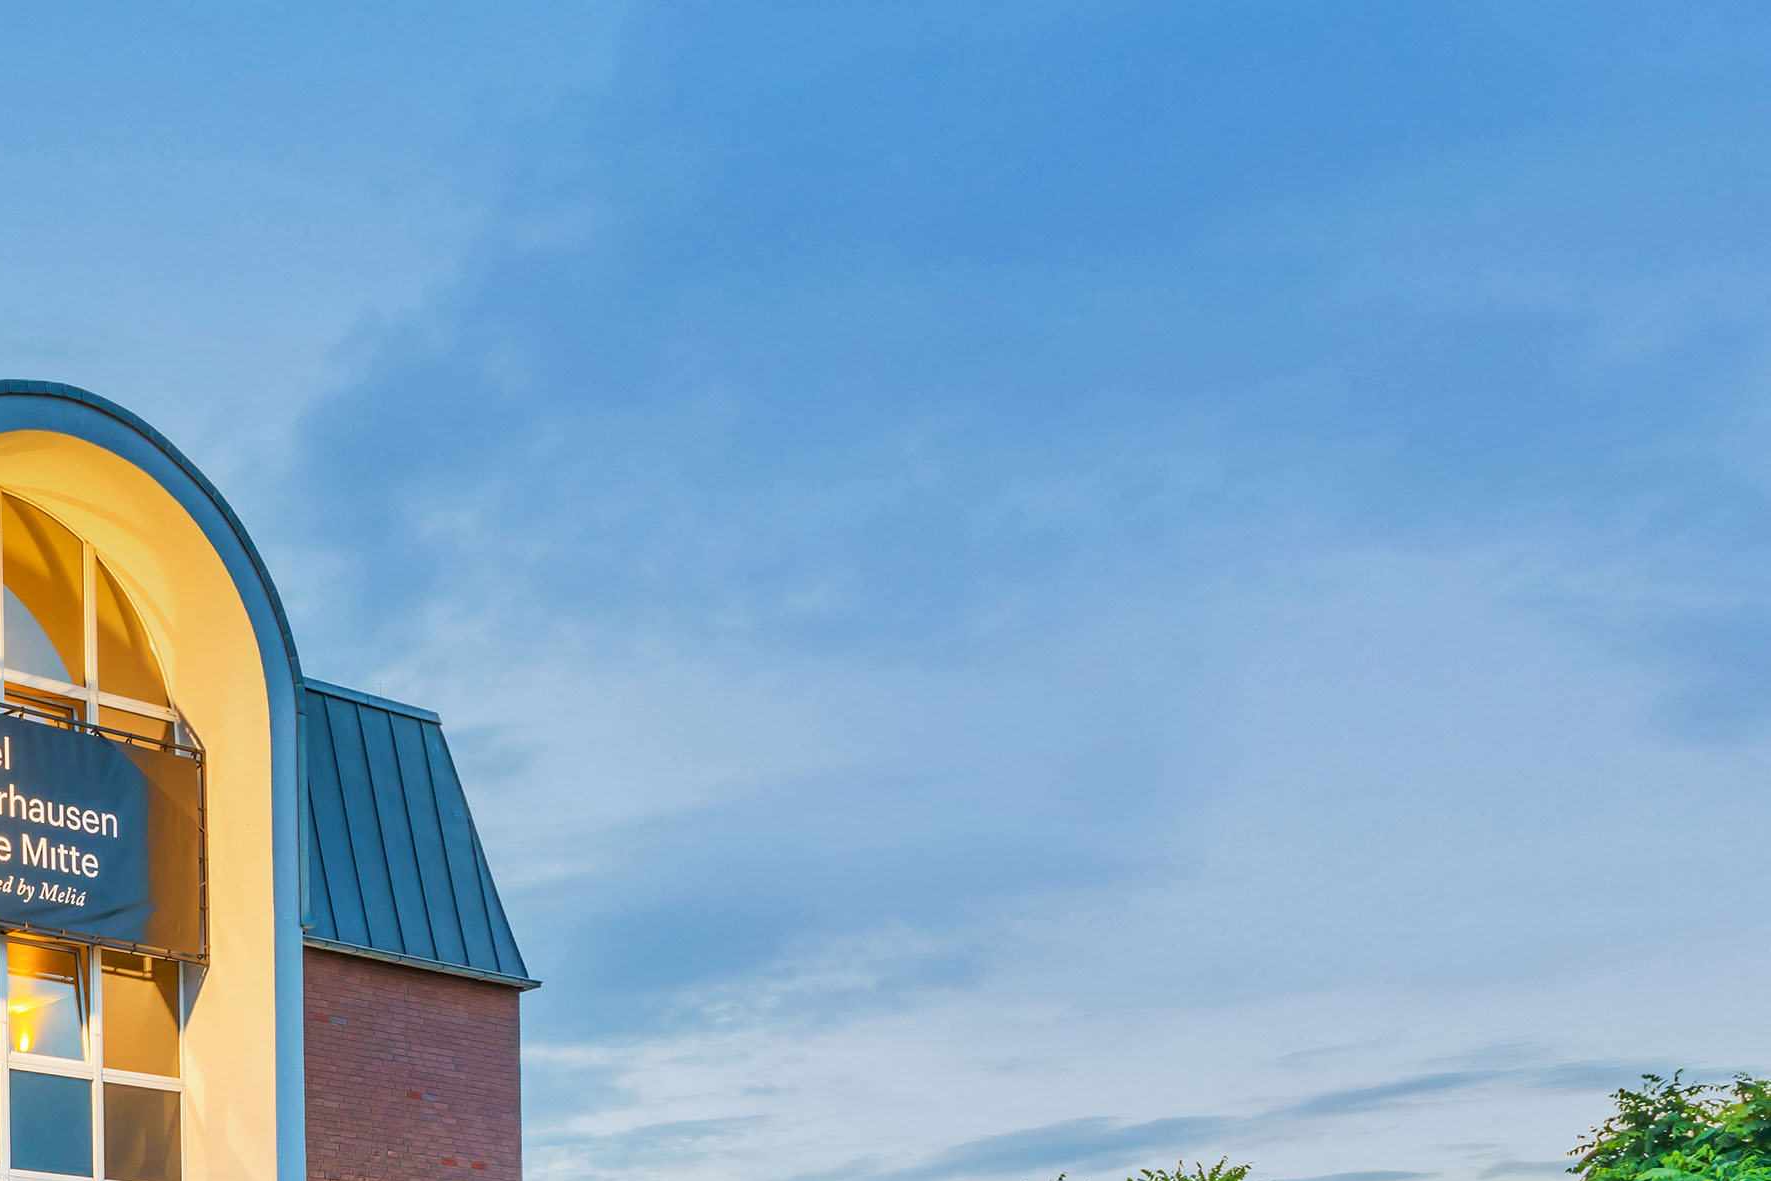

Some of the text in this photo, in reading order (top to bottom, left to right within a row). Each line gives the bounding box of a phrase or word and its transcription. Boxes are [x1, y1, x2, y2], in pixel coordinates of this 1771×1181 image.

[21, 833, 100, 878] Mitte
[16, 877, 36, 903] by
[39, 882, 86, 907] Meliá
